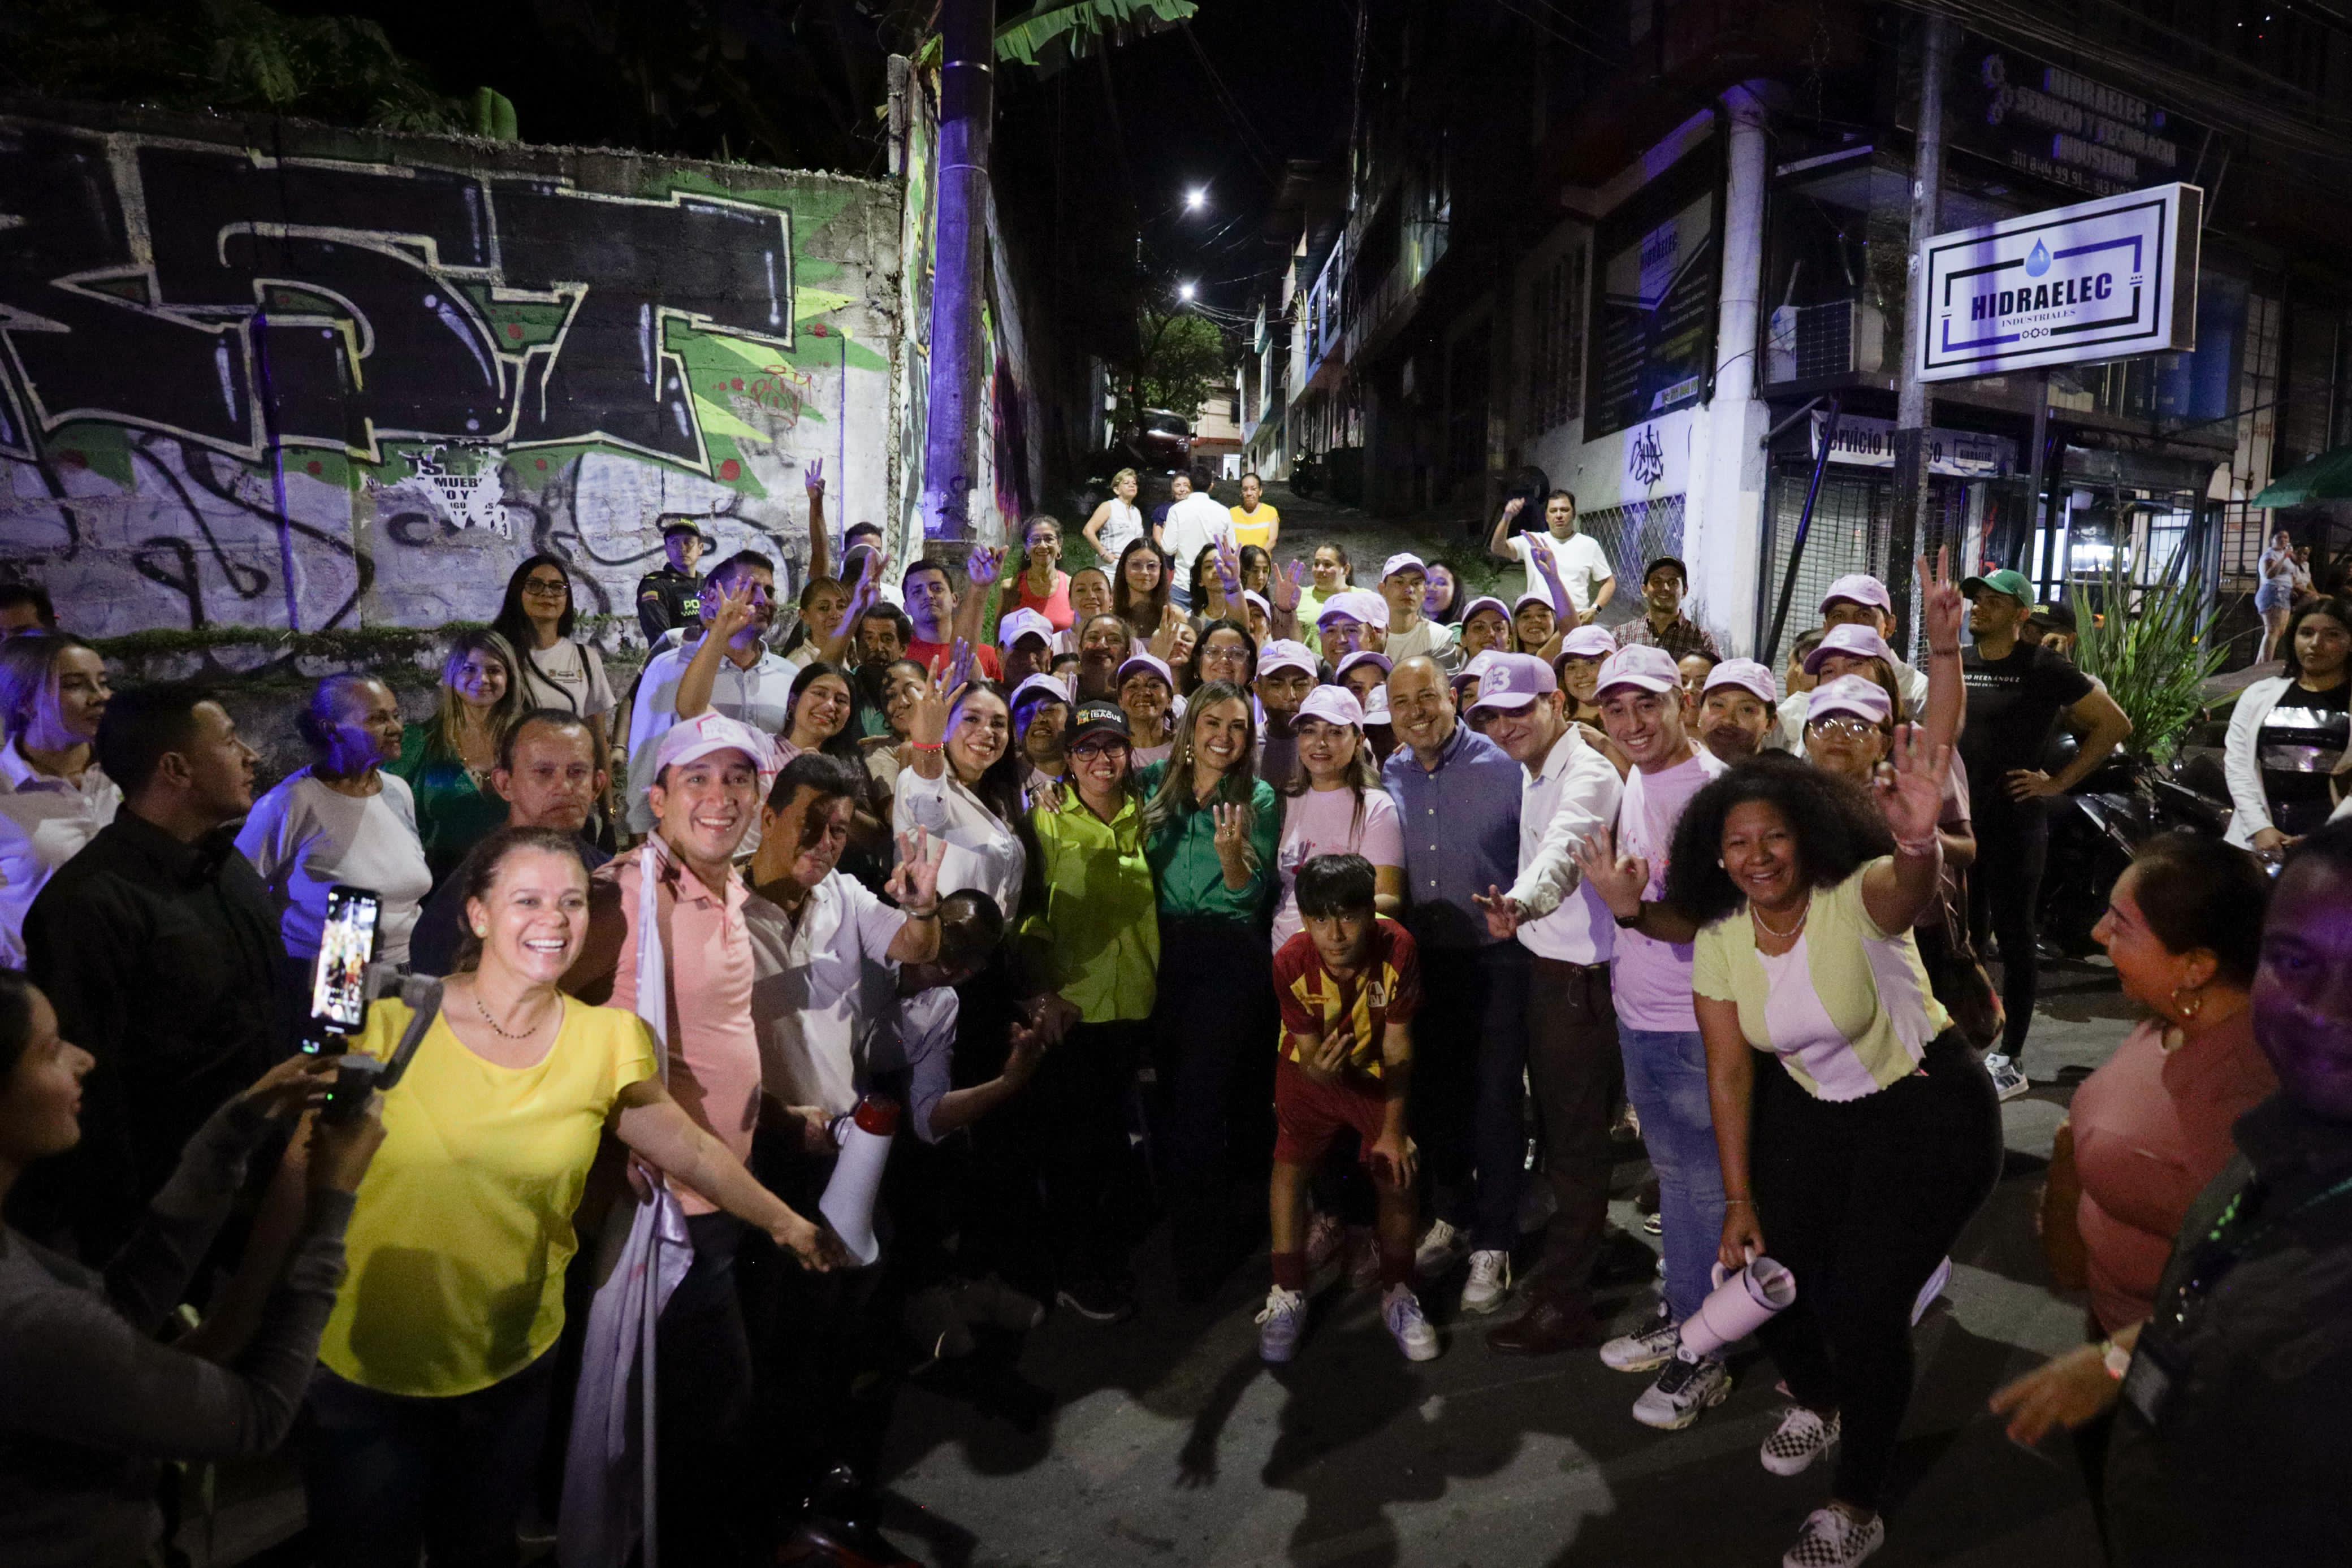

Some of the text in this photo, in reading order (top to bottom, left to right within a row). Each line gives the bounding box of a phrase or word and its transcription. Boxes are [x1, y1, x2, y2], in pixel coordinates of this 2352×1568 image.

[2011, 149, 2027, 168] 311
[2030, 156, 2052, 177] 844
[2055, 167, 2069, 182] 99
[2071, 173, 2082, 187] 91
[1971, 272, 2113, 322] HIDRAELEC
[2001, 309, 2077, 328] INDUSTRIALES
[1492, 665, 1511, 692] 3
